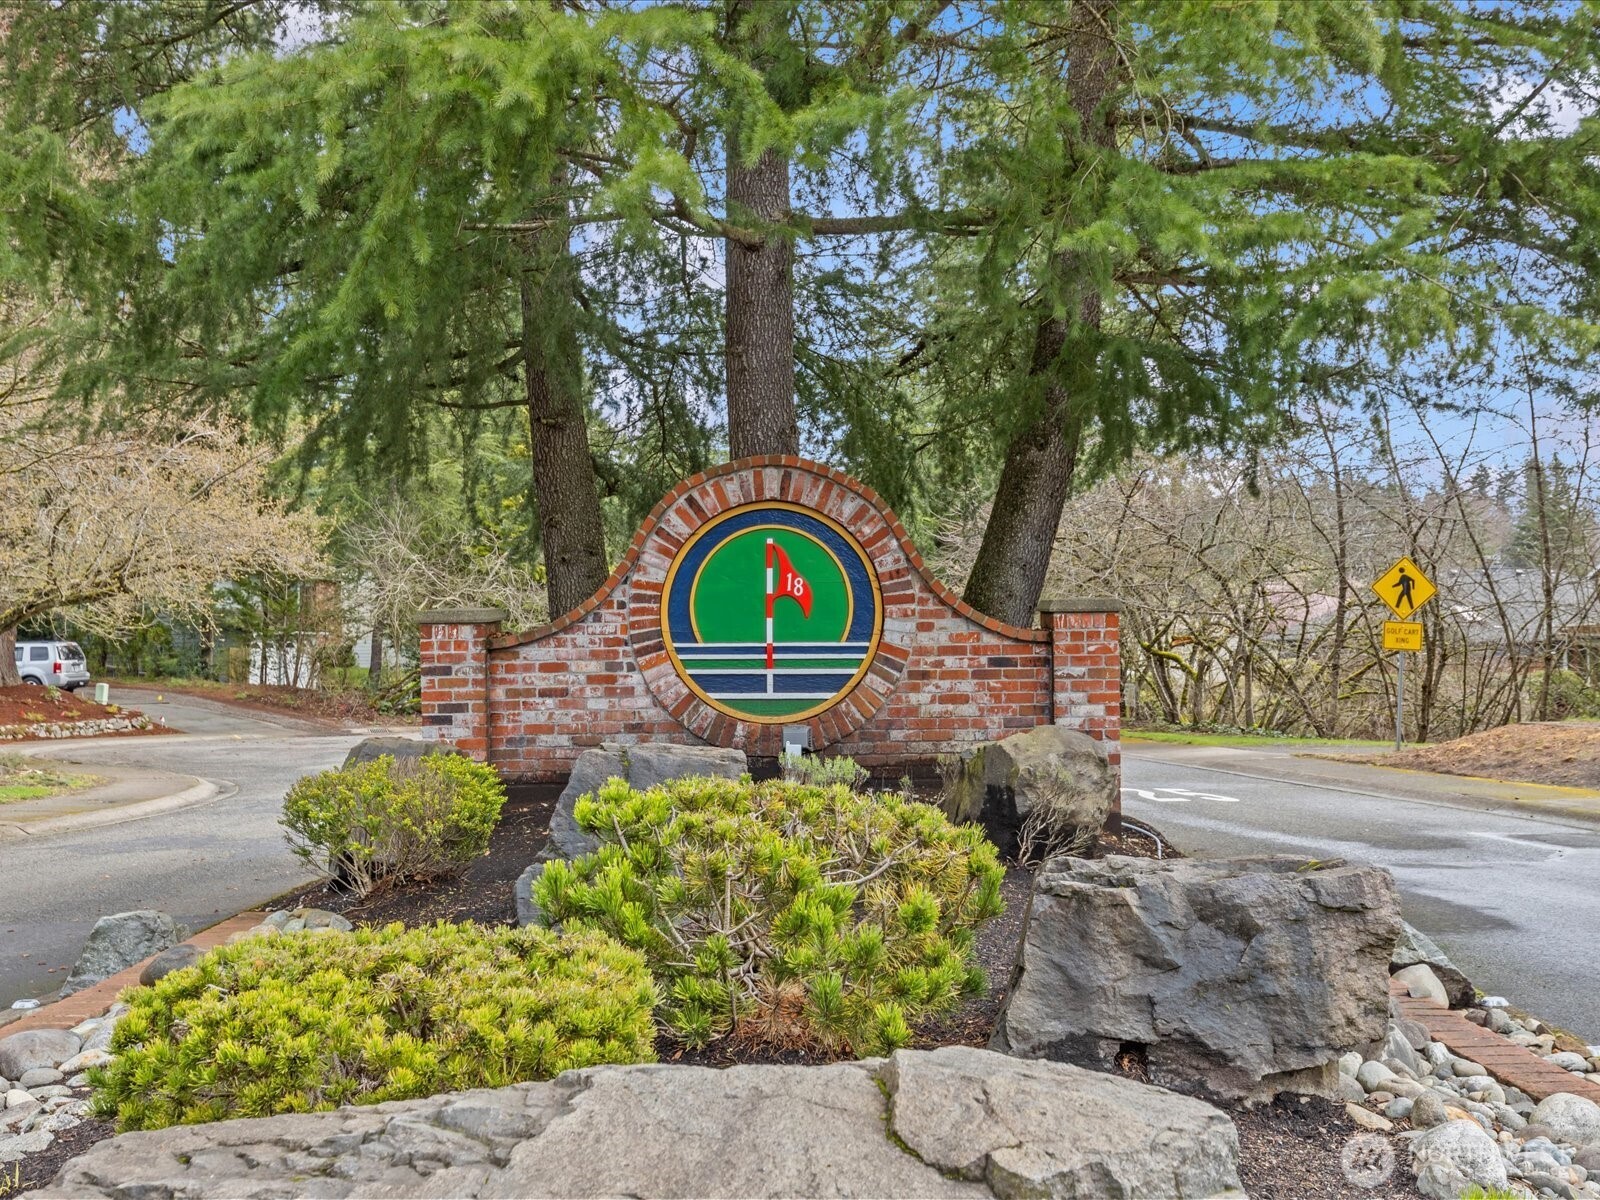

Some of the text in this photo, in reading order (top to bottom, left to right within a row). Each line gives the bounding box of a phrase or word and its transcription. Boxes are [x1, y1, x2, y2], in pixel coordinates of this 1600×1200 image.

[786, 572, 804, 597] 18
[1386, 627, 1419, 636] GOLF CART
[1120, 788, 1240, 802] 25
